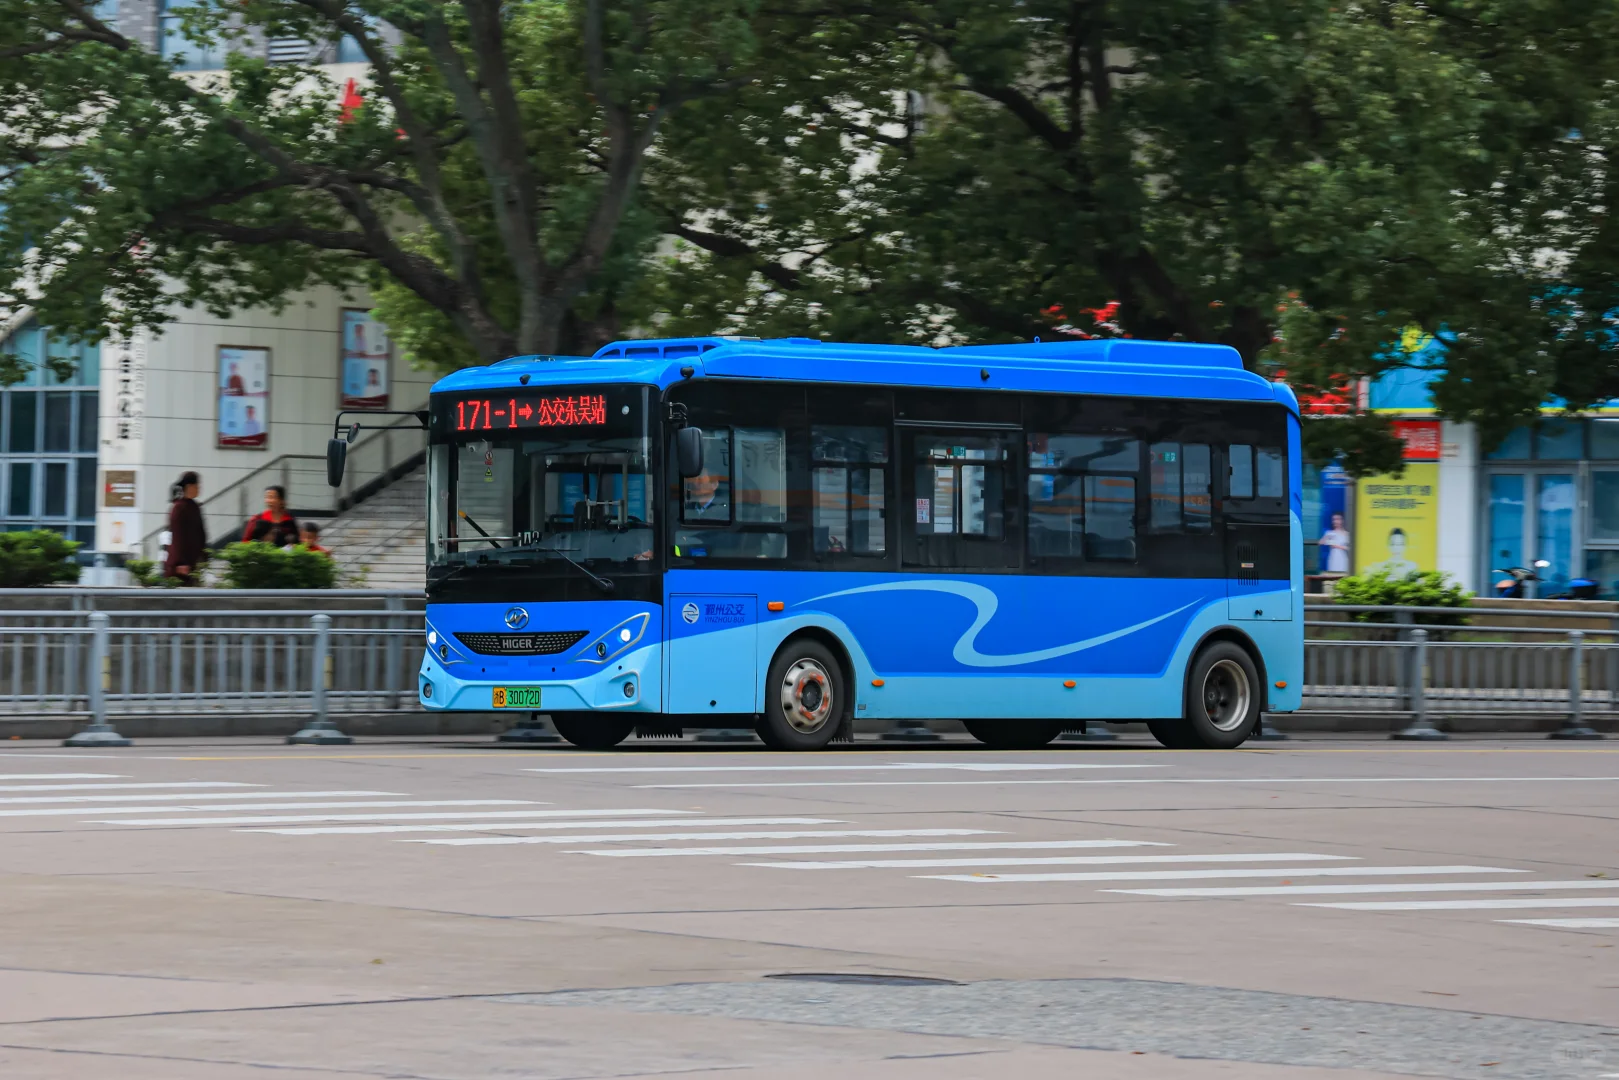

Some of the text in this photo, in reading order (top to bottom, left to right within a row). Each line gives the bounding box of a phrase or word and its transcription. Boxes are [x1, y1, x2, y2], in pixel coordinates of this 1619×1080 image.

[457, 395, 606, 430] 171-1 公交东吴站
[704, 616, 745, 624] YINZHOU BUS
[502, 639, 532, 648] HIGER
